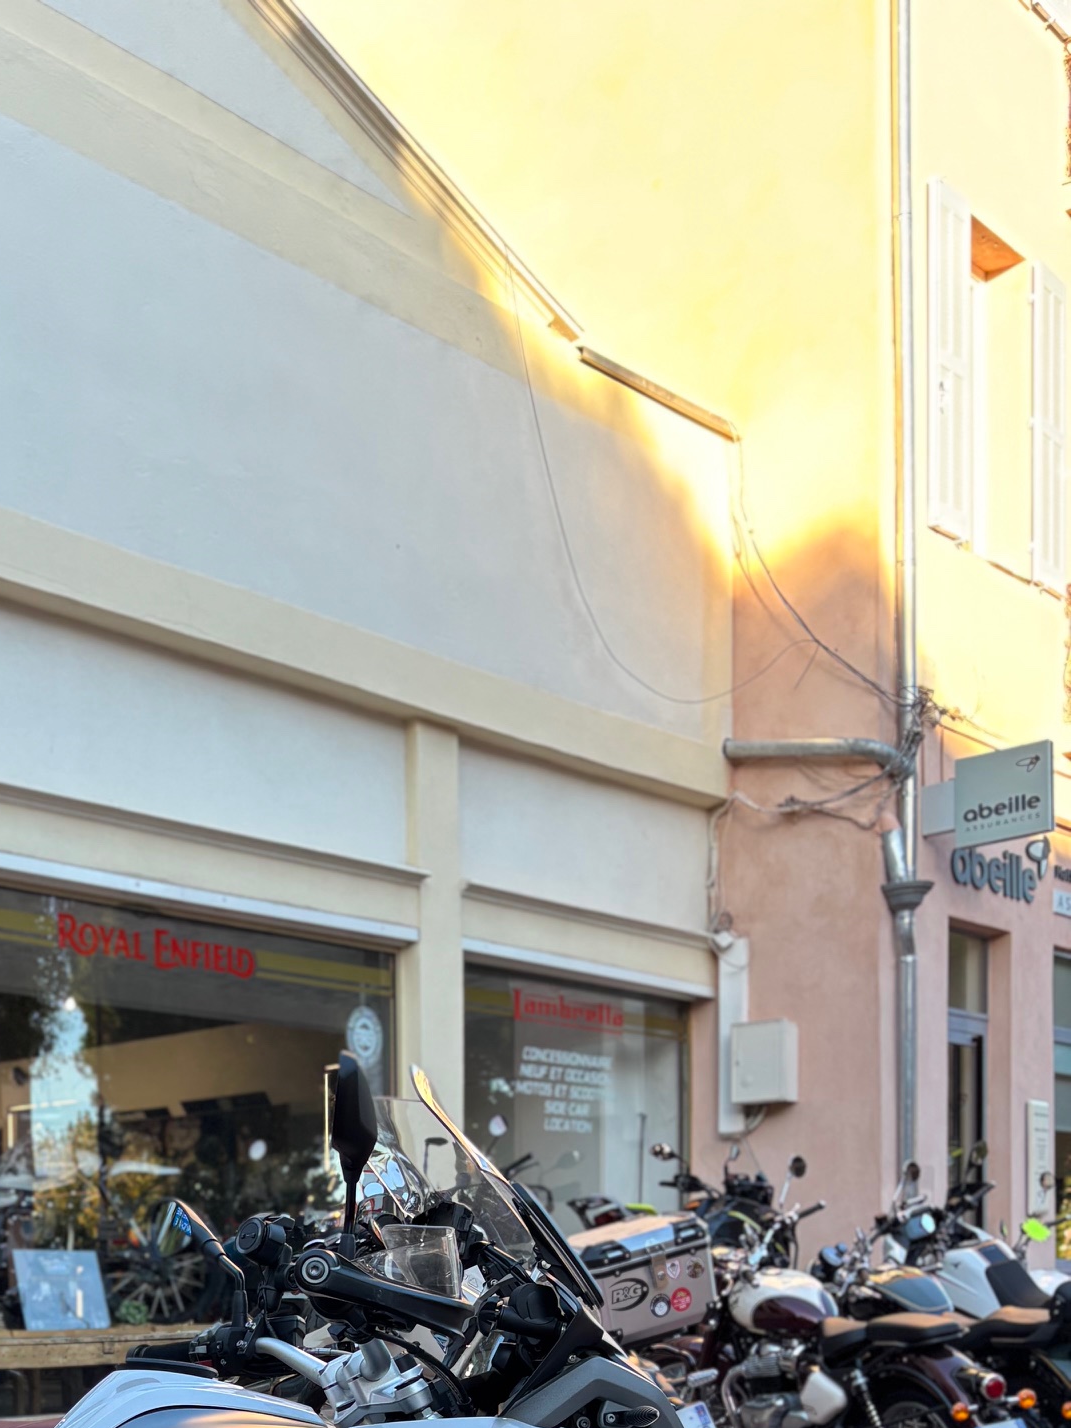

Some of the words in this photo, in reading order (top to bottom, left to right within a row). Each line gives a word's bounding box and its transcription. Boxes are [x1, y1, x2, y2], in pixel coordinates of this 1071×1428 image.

[963, 794, 1041, 823] abeille
[964, 812, 1041, 832] ASSURANCES
[951, 848, 1038, 905] abeille
[57, 912, 148, 962] ROYAL
[153, 927, 257, 980] ENFIELD
[611, 1282, 643, 1305] R&G
